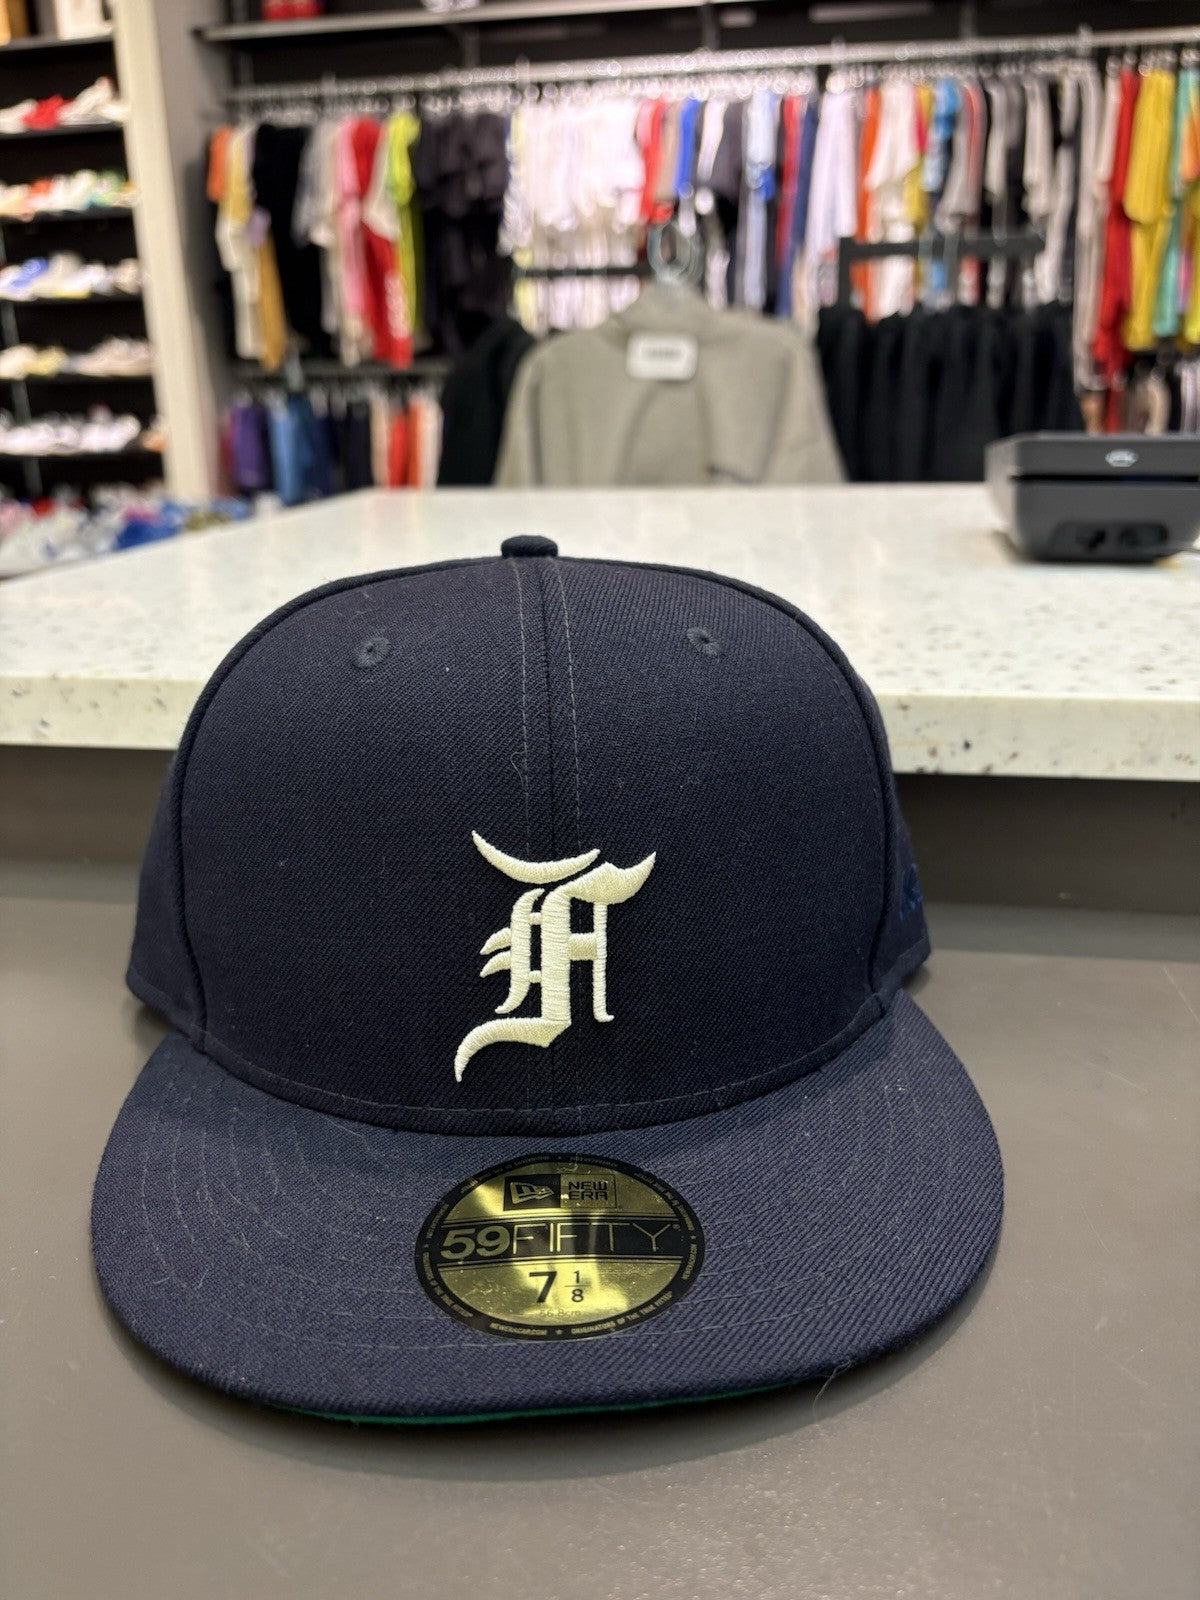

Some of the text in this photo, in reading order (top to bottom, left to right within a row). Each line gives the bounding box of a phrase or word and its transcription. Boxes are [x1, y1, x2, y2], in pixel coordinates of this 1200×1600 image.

[568, 1181, 607, 1190] NEW
[568, 1191, 607, 1200] ERA
[528, 1270, 558, 1304] 7
